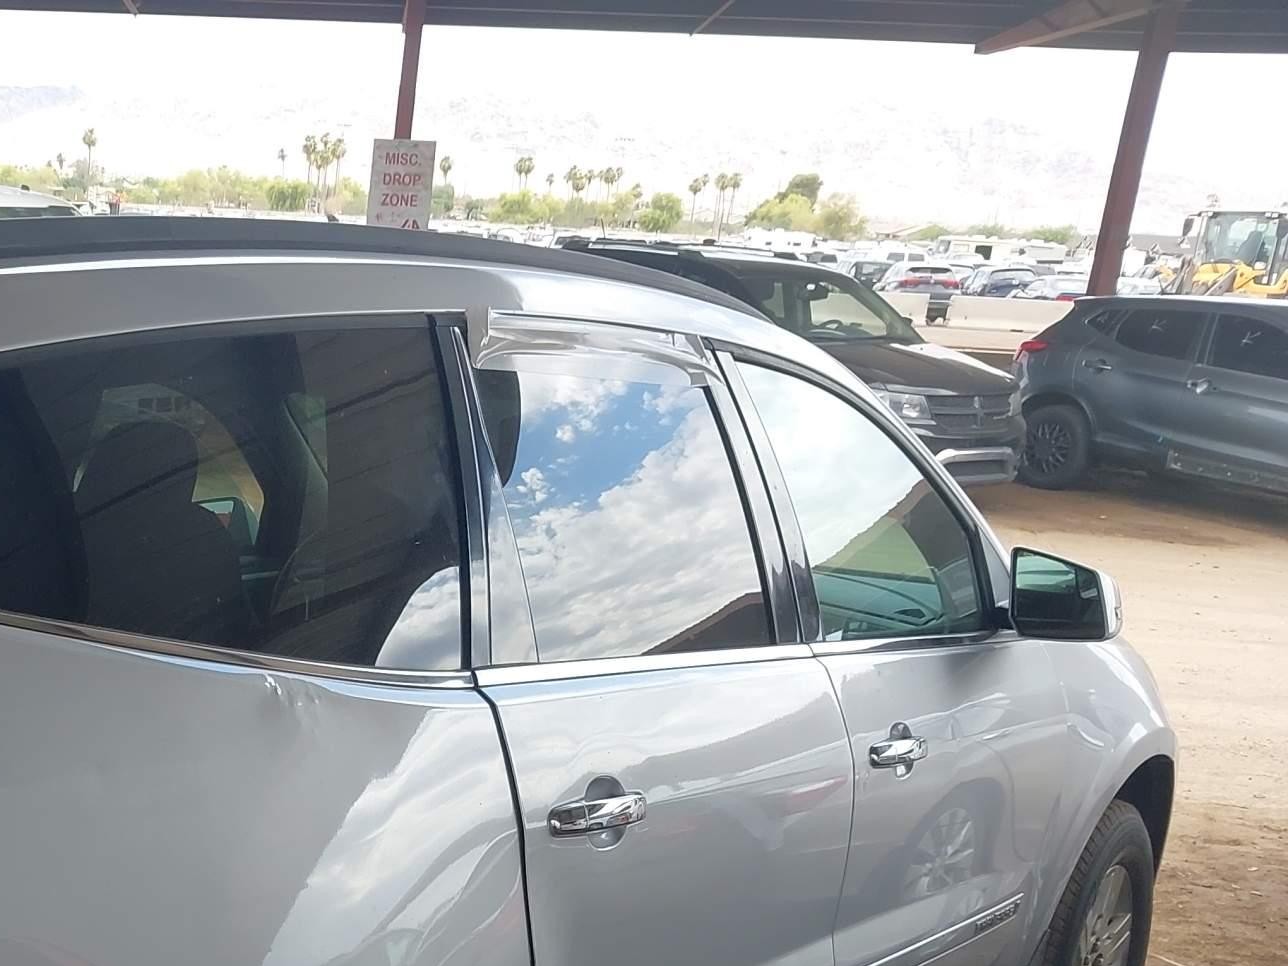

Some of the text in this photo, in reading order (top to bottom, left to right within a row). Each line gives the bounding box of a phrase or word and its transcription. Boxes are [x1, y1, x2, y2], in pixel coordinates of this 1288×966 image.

[385, 152, 422, 166] MISC.
[383, 172, 421, 186] DROP
[381, 193, 418, 208] ZONE
